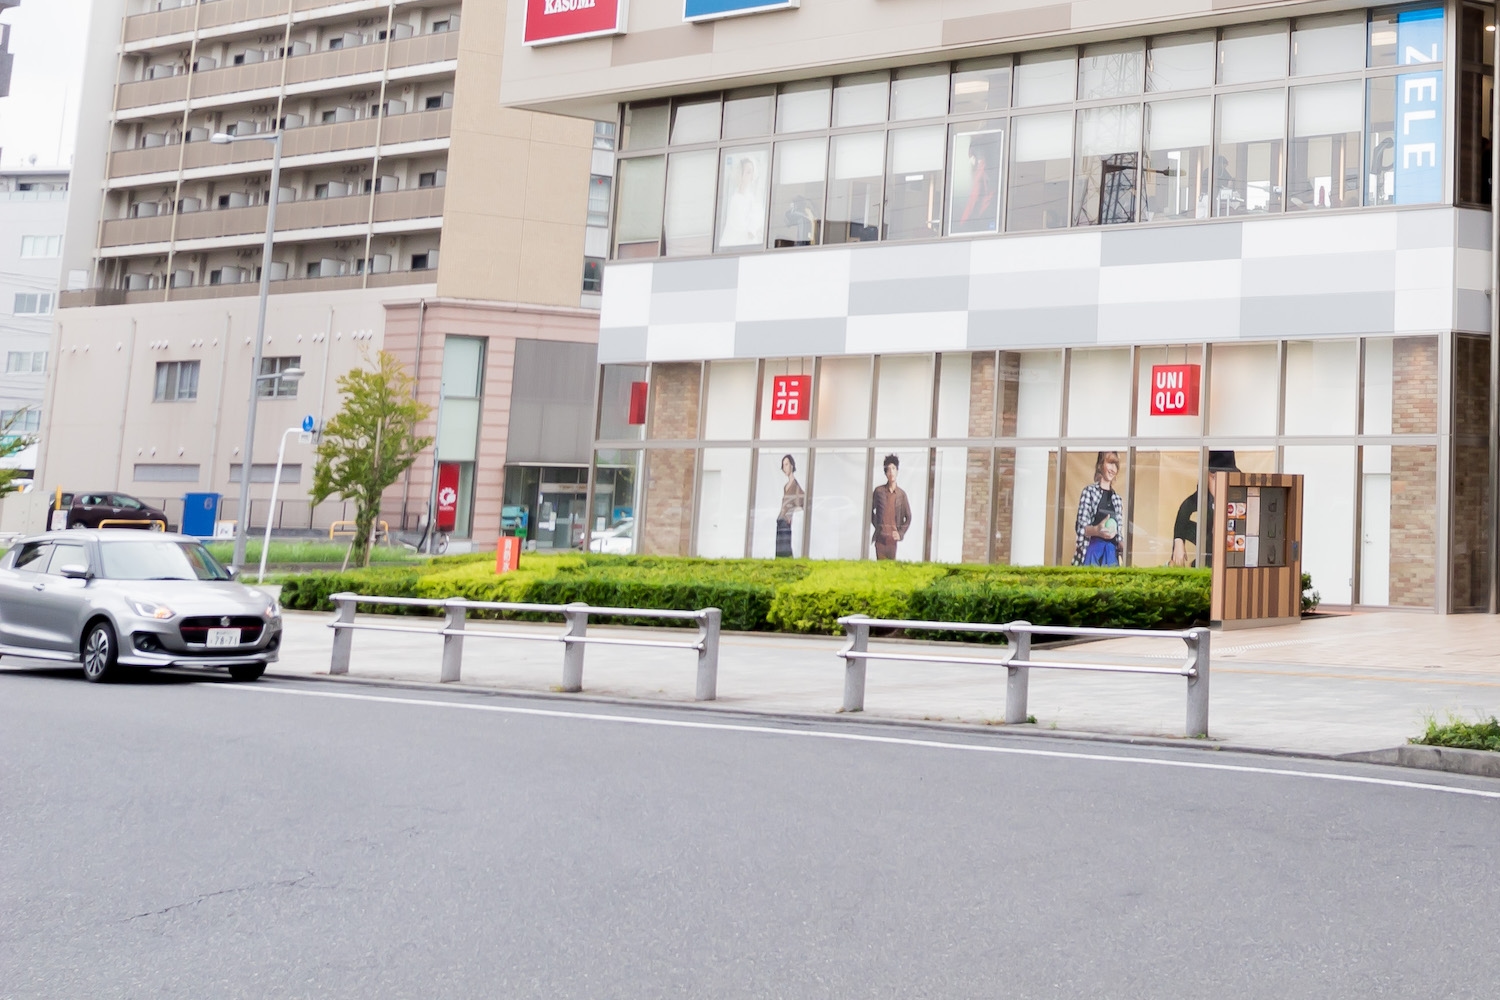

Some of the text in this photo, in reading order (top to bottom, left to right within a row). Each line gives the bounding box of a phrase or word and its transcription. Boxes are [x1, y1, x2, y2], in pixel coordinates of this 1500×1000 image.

[1403, 43, 1437, 170] ZELE
[777, 381, 799, 397] ユニ
[1156, 371, 1183, 389] UNI
[775, 398, 799, 415] クロ
[1155, 391, 1185, 412] QLO
